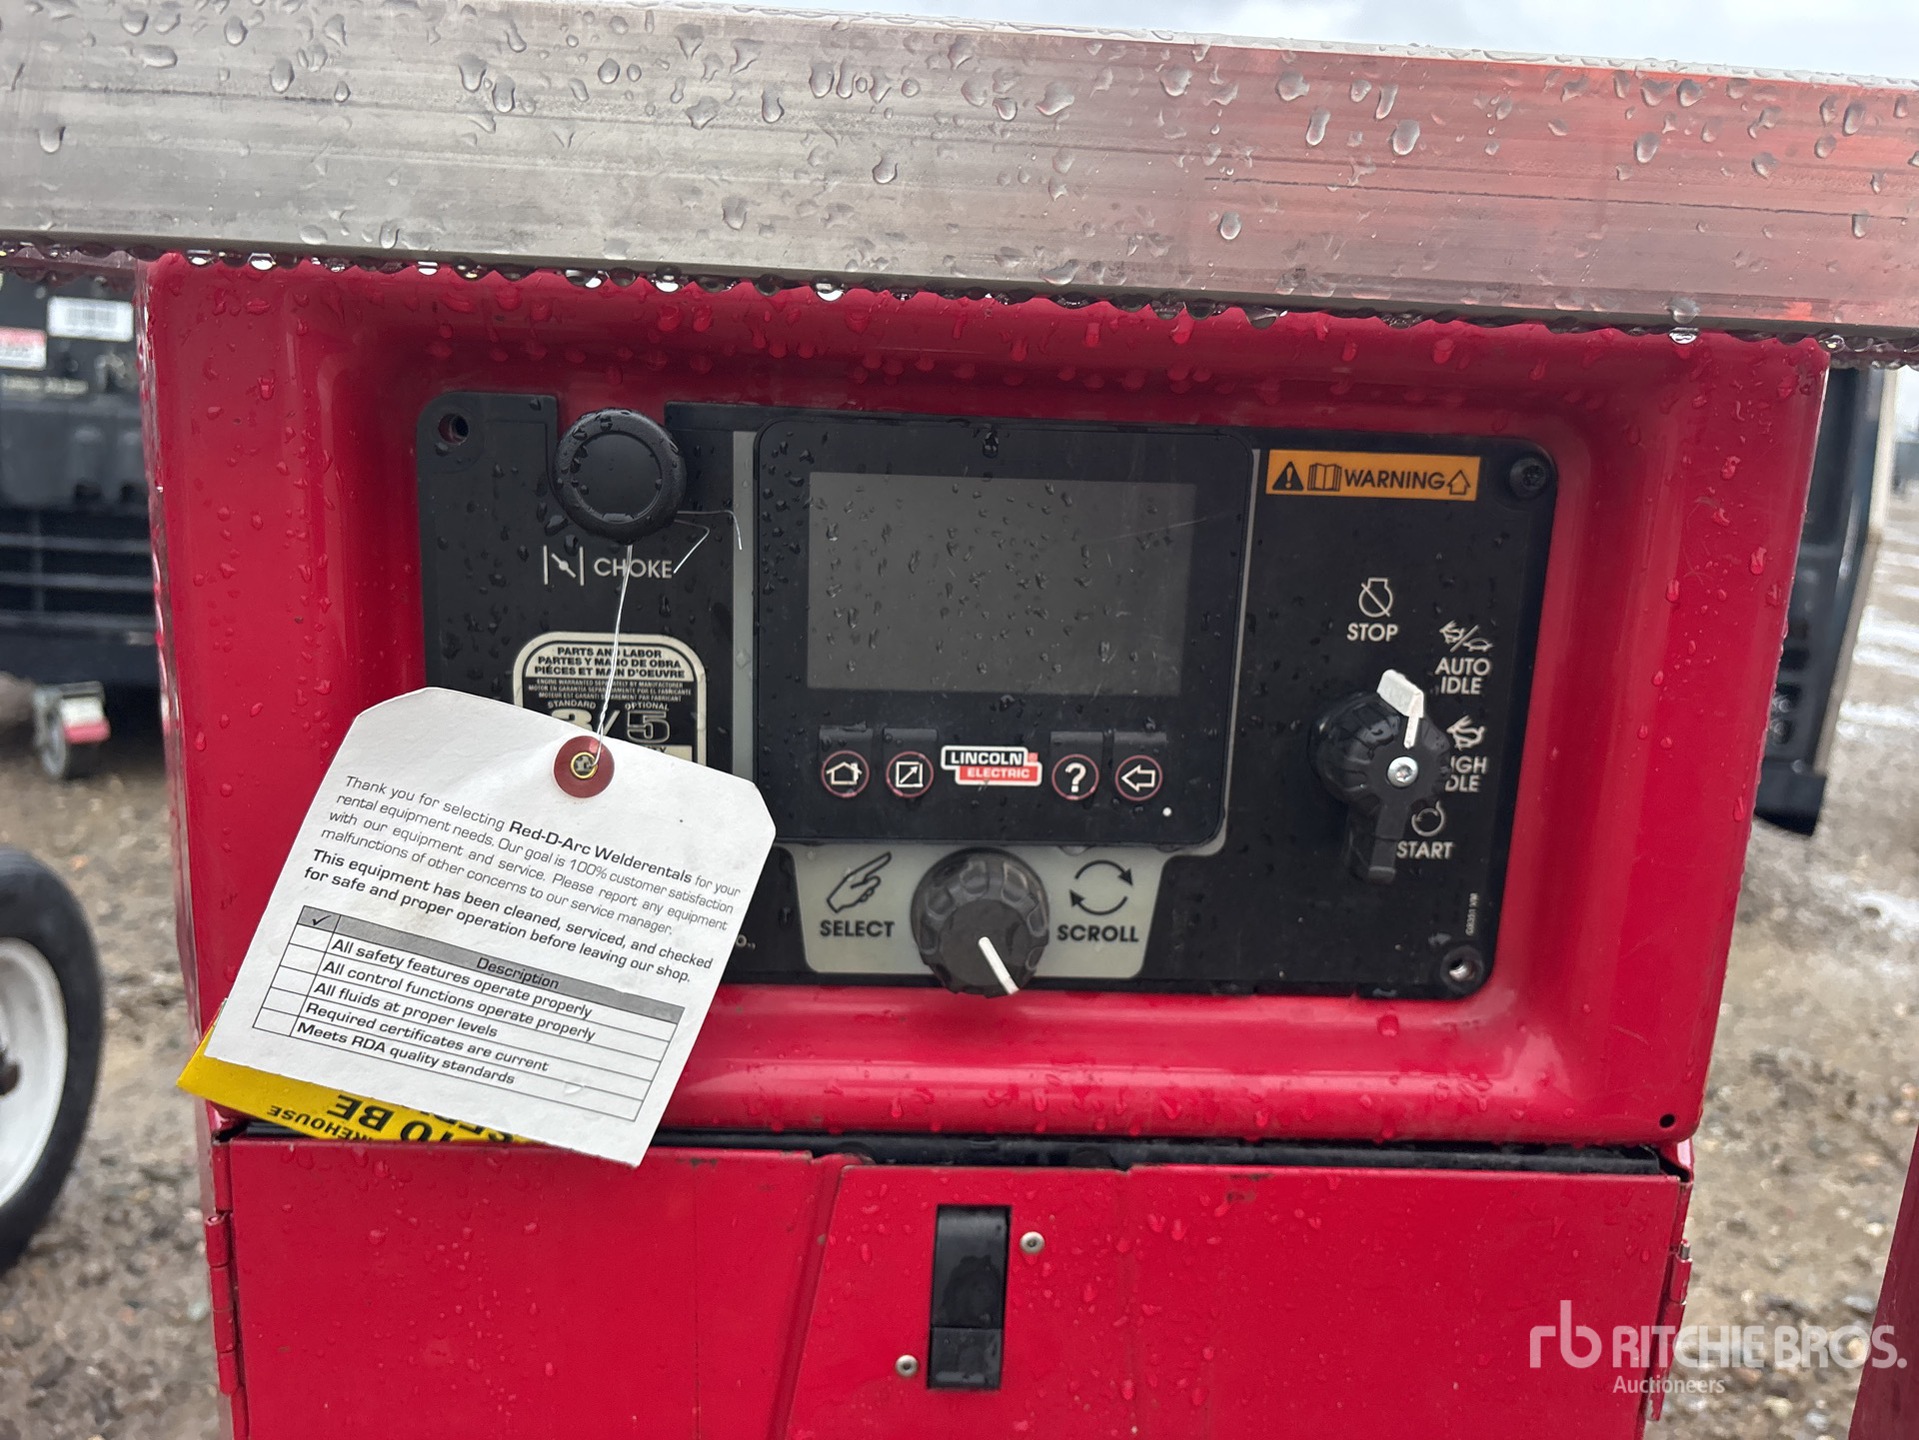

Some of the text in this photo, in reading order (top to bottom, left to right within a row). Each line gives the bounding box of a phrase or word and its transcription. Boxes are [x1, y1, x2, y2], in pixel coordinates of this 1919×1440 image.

[1344, 469, 1445, 490] WARNING
[593, 558, 673, 579] CHOKE
[1346, 623, 1398, 642] STOP
[538, 656, 583, 666] PARTES
[585, 657, 593, 666] Y
[631, 658, 647, 668] DE
[649, 659, 681, 669] OBRA
[557, 647, 595, 657] PARTS
[623, 648, 662, 658] LABOR
[578, 667, 593, 676] ET
[627, 668, 685, 679] D'OEUVRE
[1434, 657, 1491, 677] AUTO
[1441, 676, 1482, 695] IDLE
[547, 700, 670, 711] STANDARD OPTIONAL
[950, 751, 1023, 766] LINCOLN
[1450, 756, 1488, 774] IGH
[967, 767, 1031, 779] ELECTRIC
[1445, 775, 1480, 793] DLE
[346, 776, 741, 897] Thank you for selecting Red-D-Arc Welderentals for your
[336, 794, 734, 914] rental equipment needs. Our goal is 100% customer satisfaction
[1396, 841, 1453, 859] START
[320, 827, 673, 936] malfunctions of other concerns to our service manager.
[328, 811, 729, 931] with our equipment and service. Please report any equipment
[313, 848, 714, 970] This equipment has been cleaned, serviced, and checked
[303, 866, 691, 984] for safe and proper operation before leaving our shop.
[819, 920, 896, 939] SELECT
[1057, 924, 1139, 943] SCROLL
[331, 938, 593, 1021] All safety features operate properly
[476, 956, 560, 990] Description
[313, 982, 499, 1038] All fluids at proper levels
[322, 960, 597, 1042] All control functions operate properly
[305, 1002, 550, 1072] Required certificates are current
[296, 1022, 516, 1085] Meets RDA quality standards
[326, 1094, 396, 1134] BE
